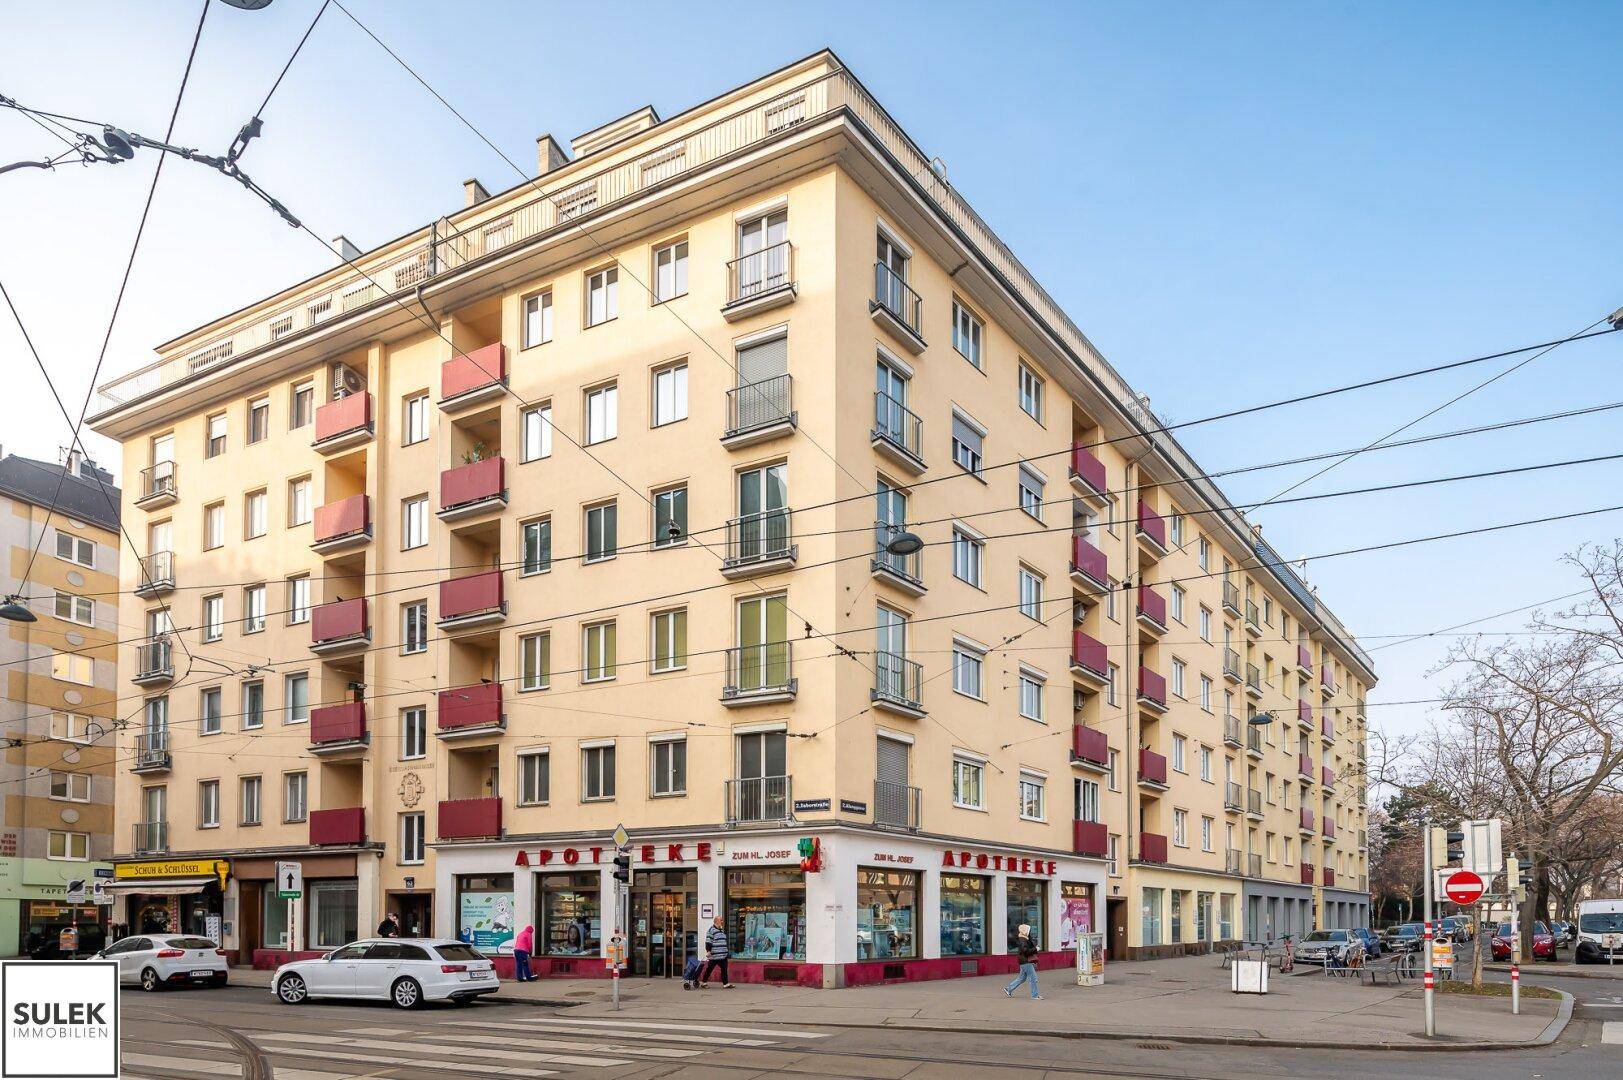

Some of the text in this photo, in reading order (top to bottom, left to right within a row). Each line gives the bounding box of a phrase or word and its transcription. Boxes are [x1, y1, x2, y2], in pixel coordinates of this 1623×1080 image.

[515, 843, 711, 866] APOTEKE
[732, 852, 749, 860] ZUM
[765, 850, 791, 859] JOSEF
[874, 853, 914, 864] ZUM HL. JOSEF
[942, 850, 1057, 875] APOTHEKE
[134, 865, 156, 875] SCHUH
[164, 864, 200, 874] SCHLÜSSEL
